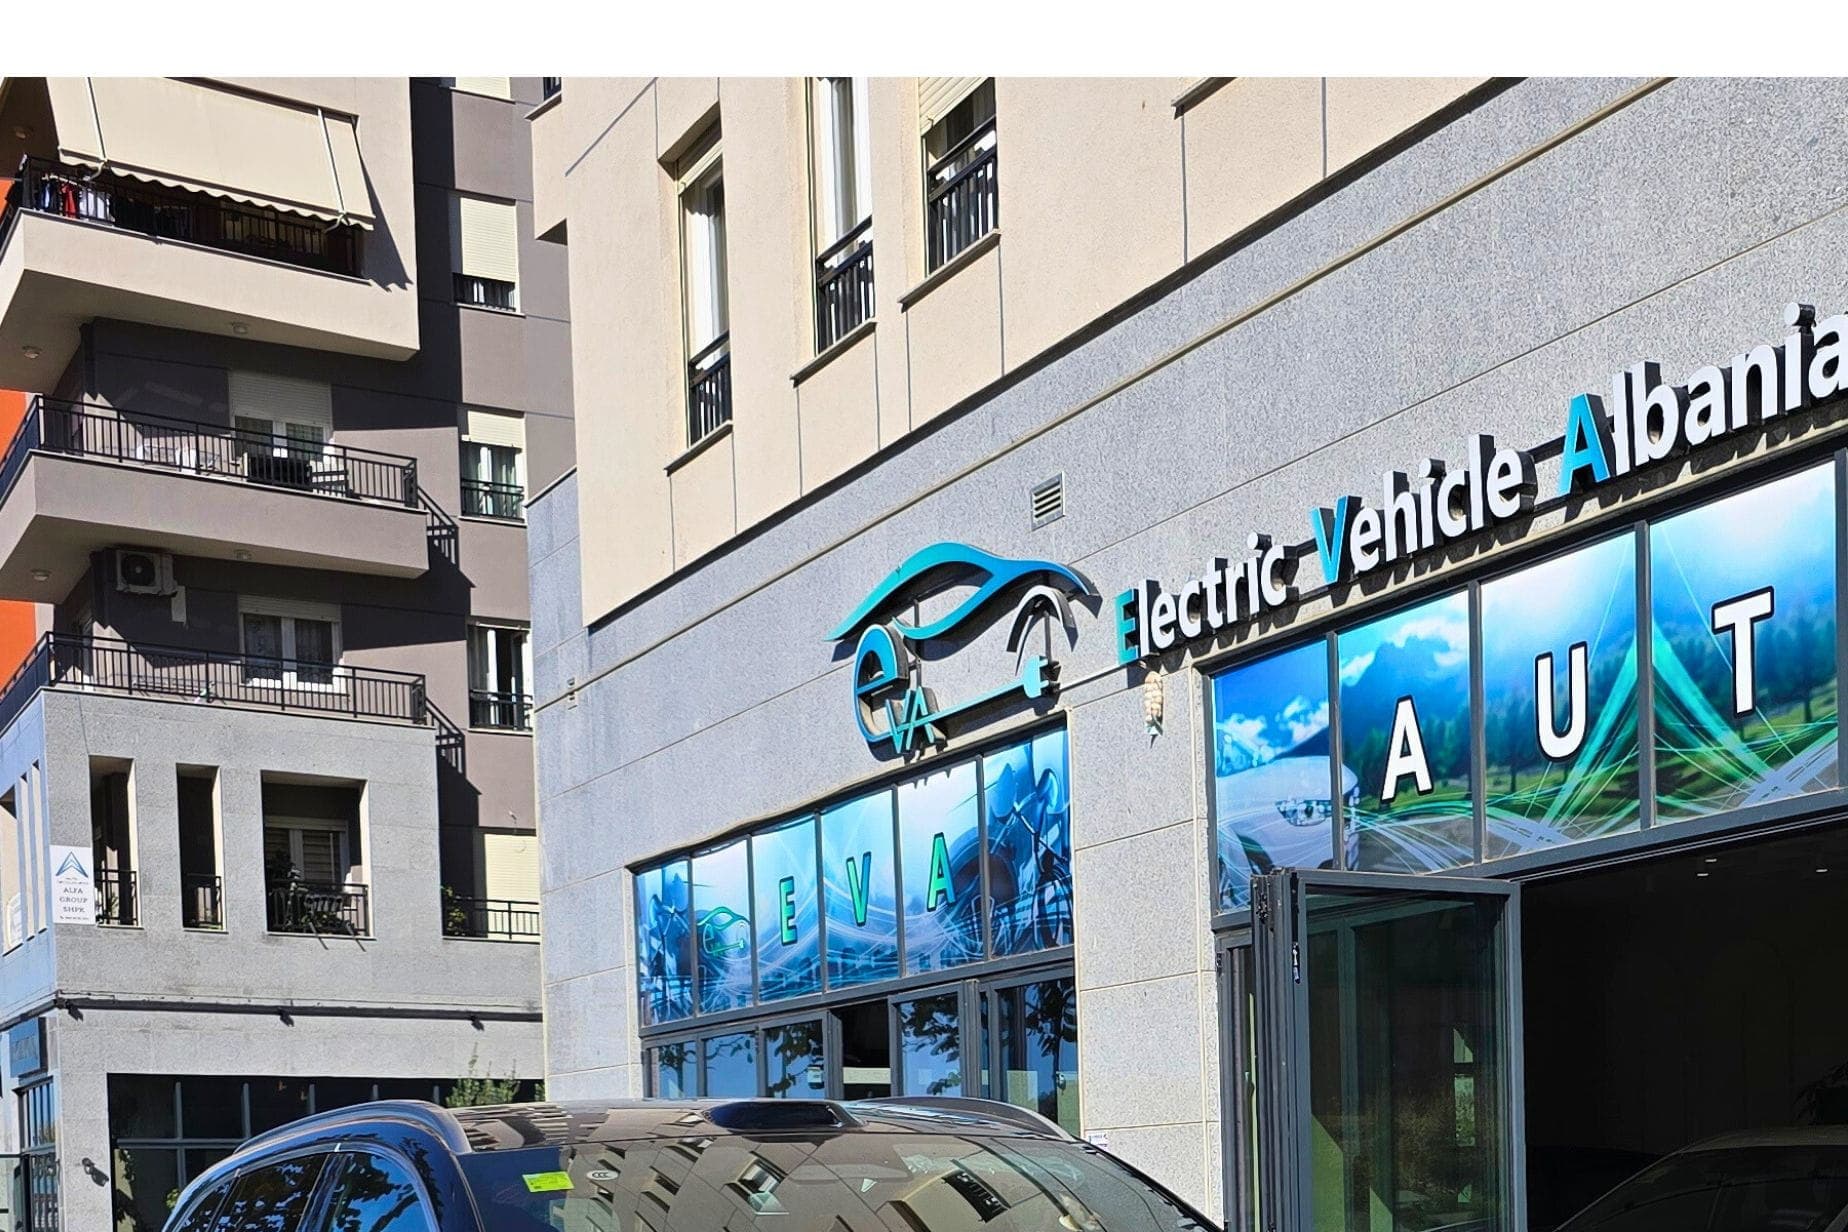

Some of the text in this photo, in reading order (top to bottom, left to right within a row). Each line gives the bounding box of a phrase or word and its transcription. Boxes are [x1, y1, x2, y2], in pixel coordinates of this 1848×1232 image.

[1115, 302, 1848, 665] Electric Vehicle Albania
